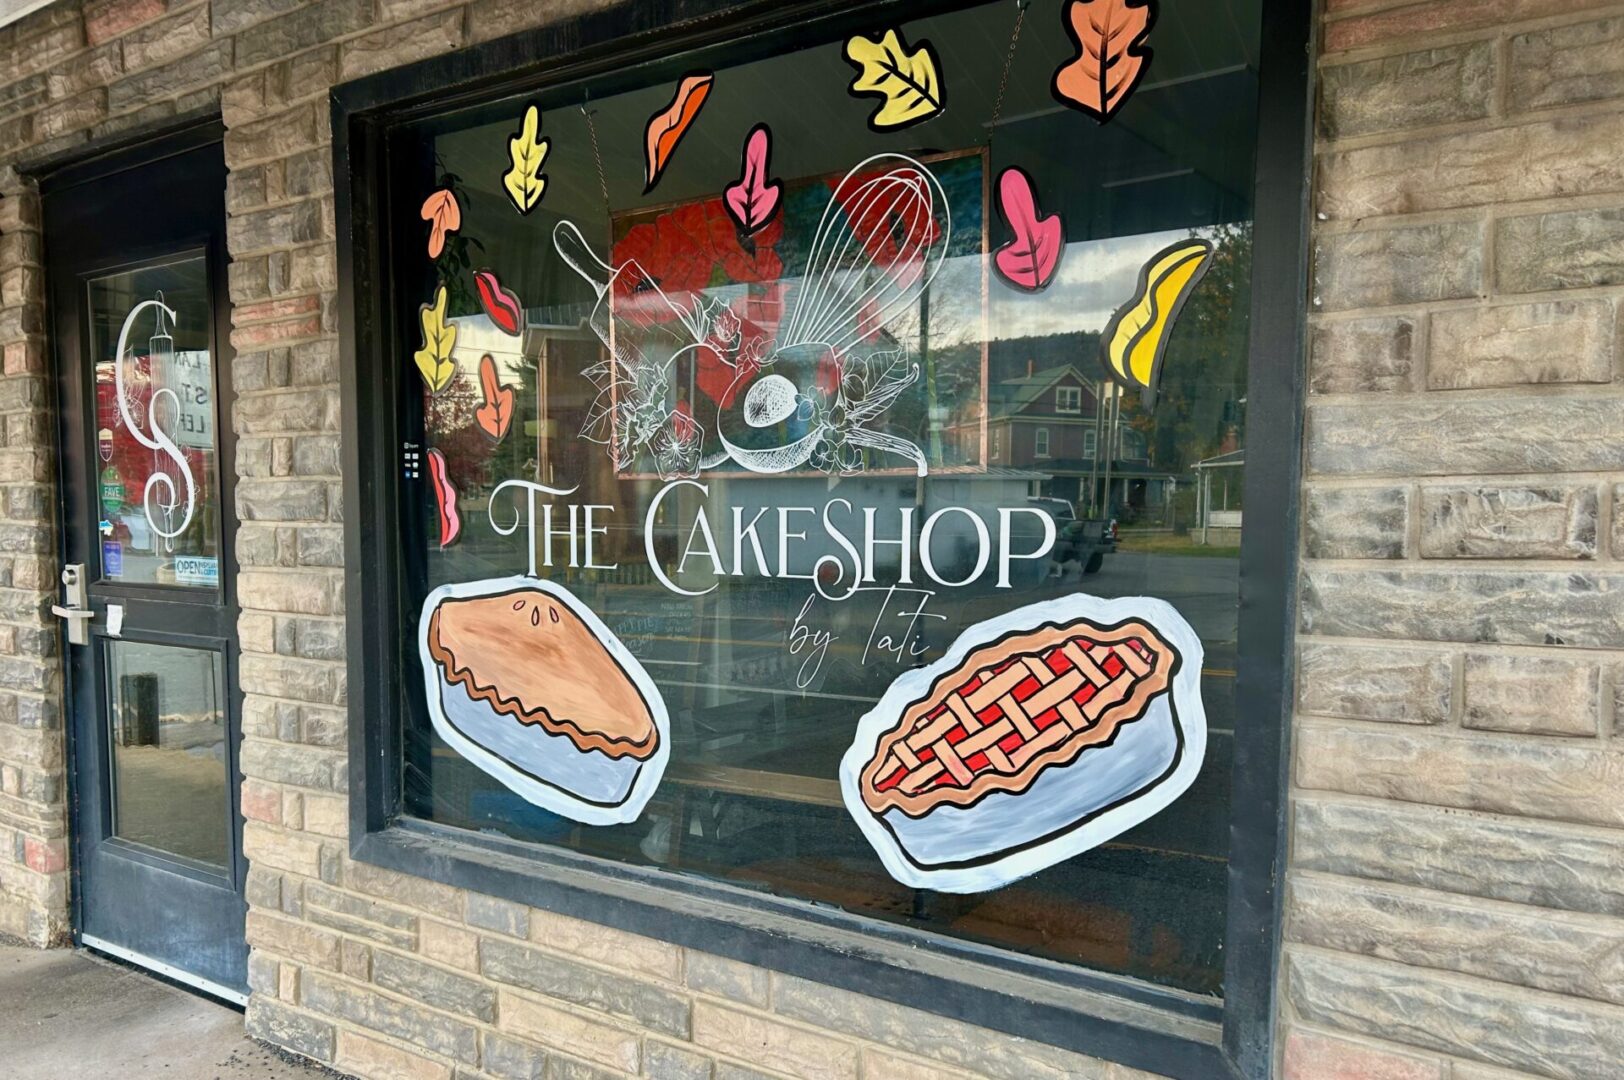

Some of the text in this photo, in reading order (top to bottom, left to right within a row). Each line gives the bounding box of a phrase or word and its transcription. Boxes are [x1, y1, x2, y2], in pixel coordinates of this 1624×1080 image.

[104, 487, 121, 497] FAVE
[177, 560, 201, 575] OPEN
[789, 584, 947, 688] by Tati
